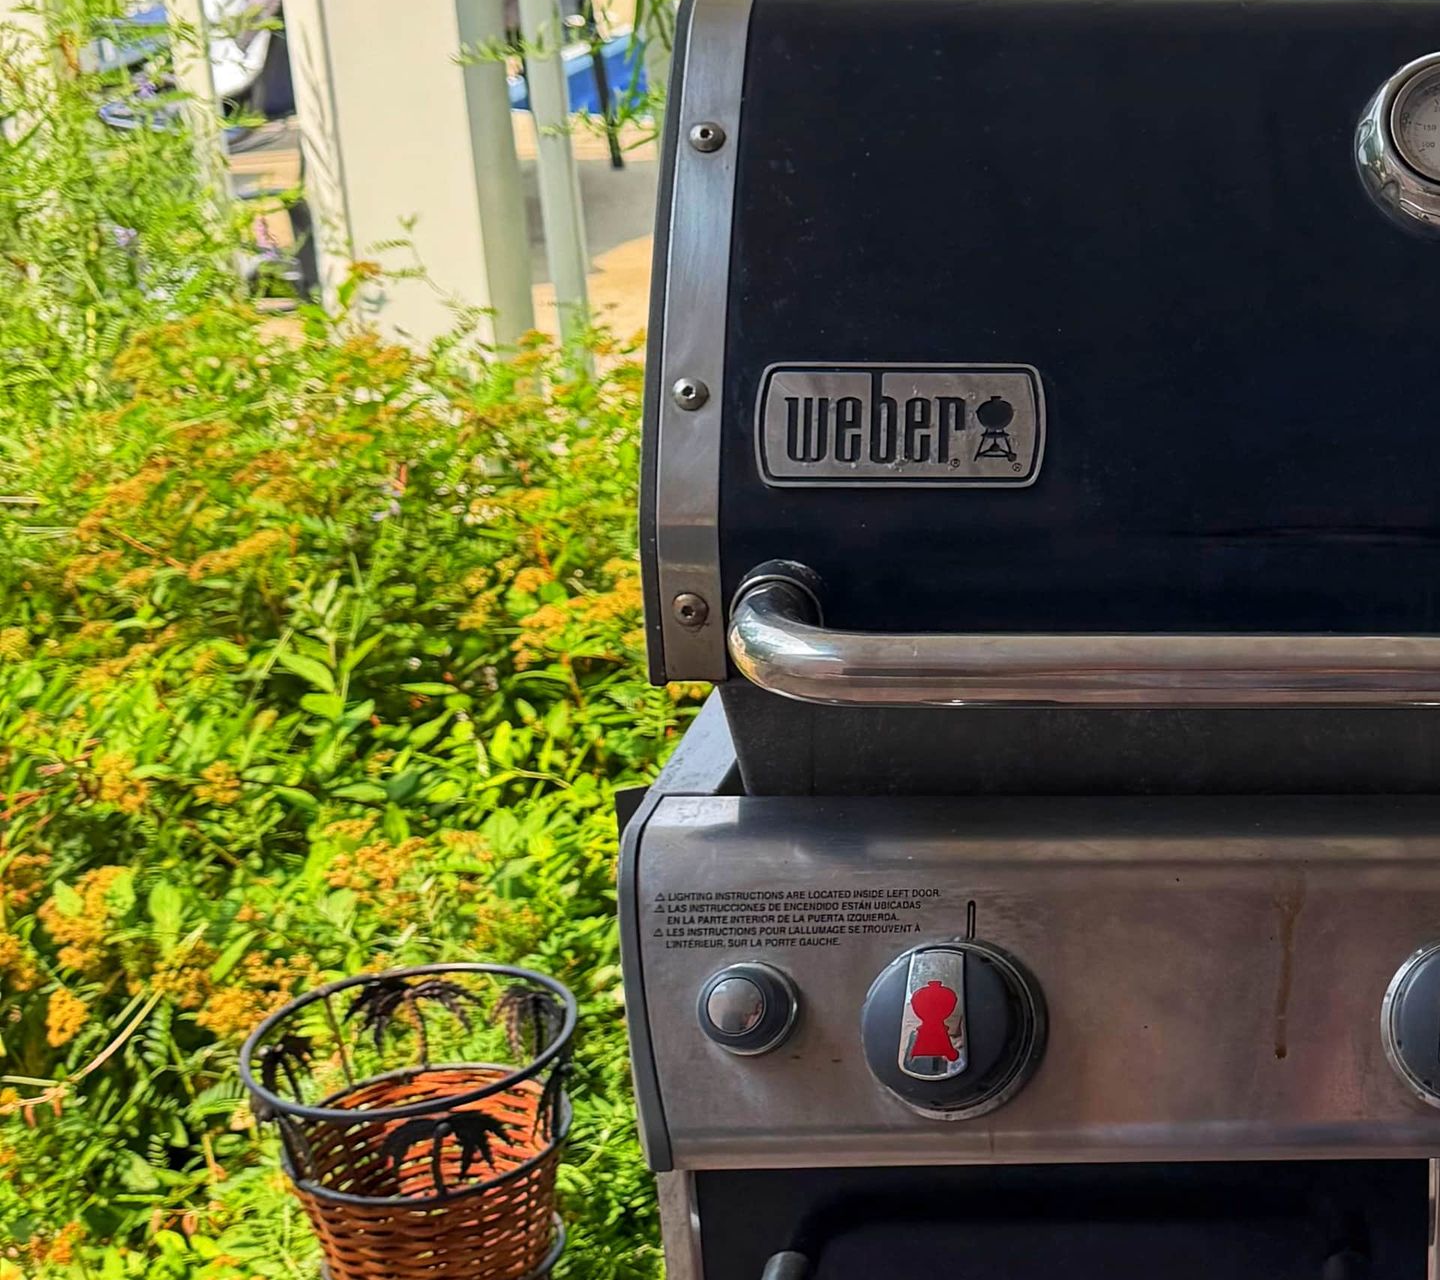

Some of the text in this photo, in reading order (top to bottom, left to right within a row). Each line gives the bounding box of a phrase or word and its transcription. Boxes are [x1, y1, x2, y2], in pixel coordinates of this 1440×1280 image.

[668, 888, 942, 902] LIGHTING INSTRUCTIONS ARE LOCATED INSIDE LEFT DOOR.
[668, 900, 922, 913] LAS INSTRUCCIONES DE ENCENDIDO ESTÁN UBICADAS
[667, 913, 901, 925] EN LA PARTE INTERIOR DE LA PUERTA IZQUIERDA.
[666, 928, 685, 937] LES
[687, 927, 757, 936] INSTRUCTIONS
[759, 926, 787, 935] POUR
[848, 925, 861, 934] SE
[862, 924, 912, 933] TROUVENT
[727, 938, 747, 947] SUR
[750, 938, 762, 947] LA
[765, 937, 797, 947] PORTE
[799, 936, 841, 946] GAUCHE.
